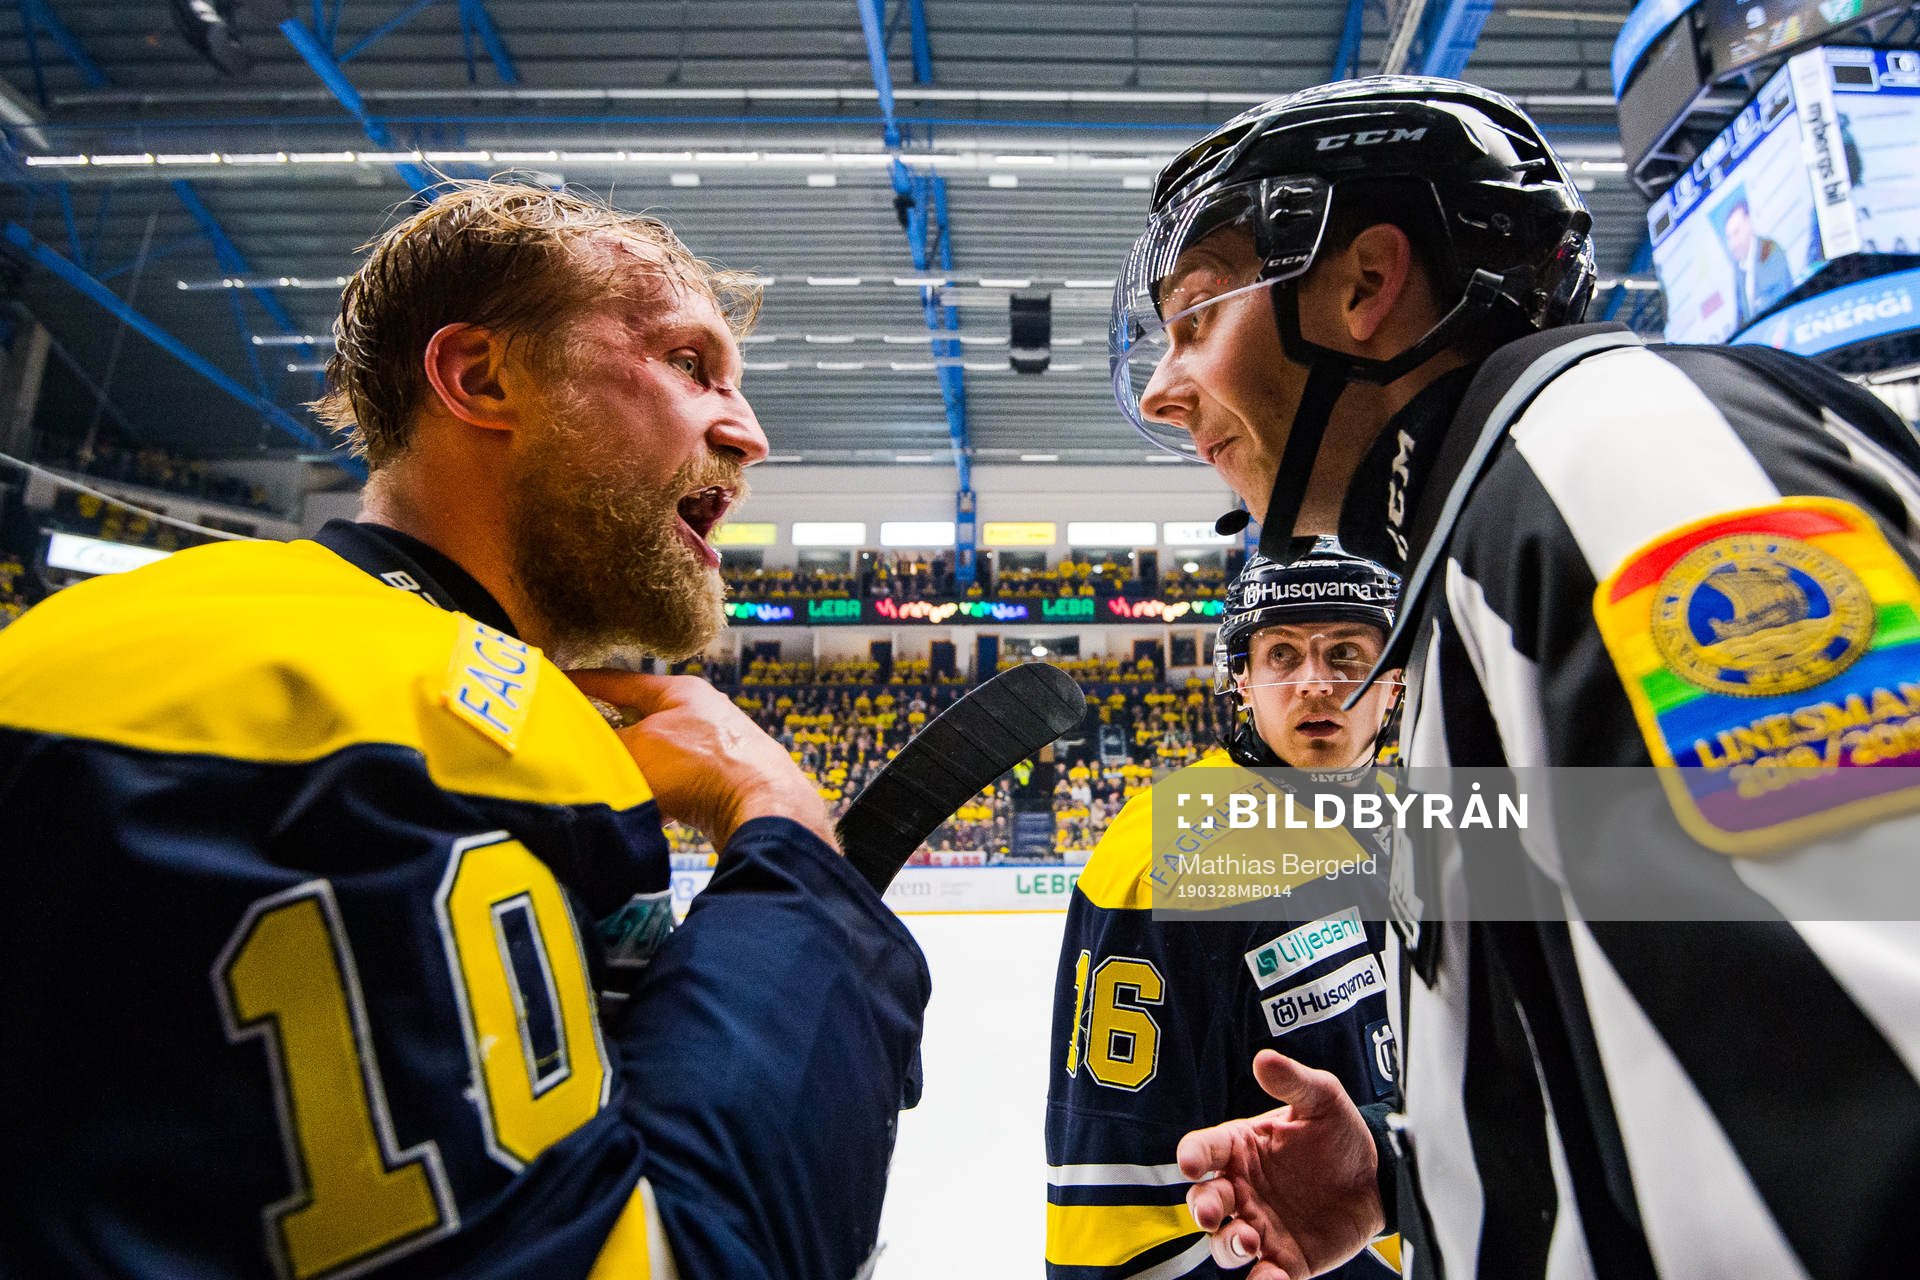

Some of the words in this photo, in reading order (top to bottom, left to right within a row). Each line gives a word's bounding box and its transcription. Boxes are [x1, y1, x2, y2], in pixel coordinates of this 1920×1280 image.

[1315, 127, 1429, 151] CCM
[1268, 254, 1309, 268] CCM
[1793, 294, 1913, 344] ENERGI
[1262, 581, 1371, 600] Husqvarna
[808, 599, 861, 617] LEBA
[1042, 598, 1095, 616] LEBA
[1277, 911, 1360, 962] Liljedahl
[1297, 969, 1376, 1016] Husqvarna
[210, 830, 613, 1280] 10
